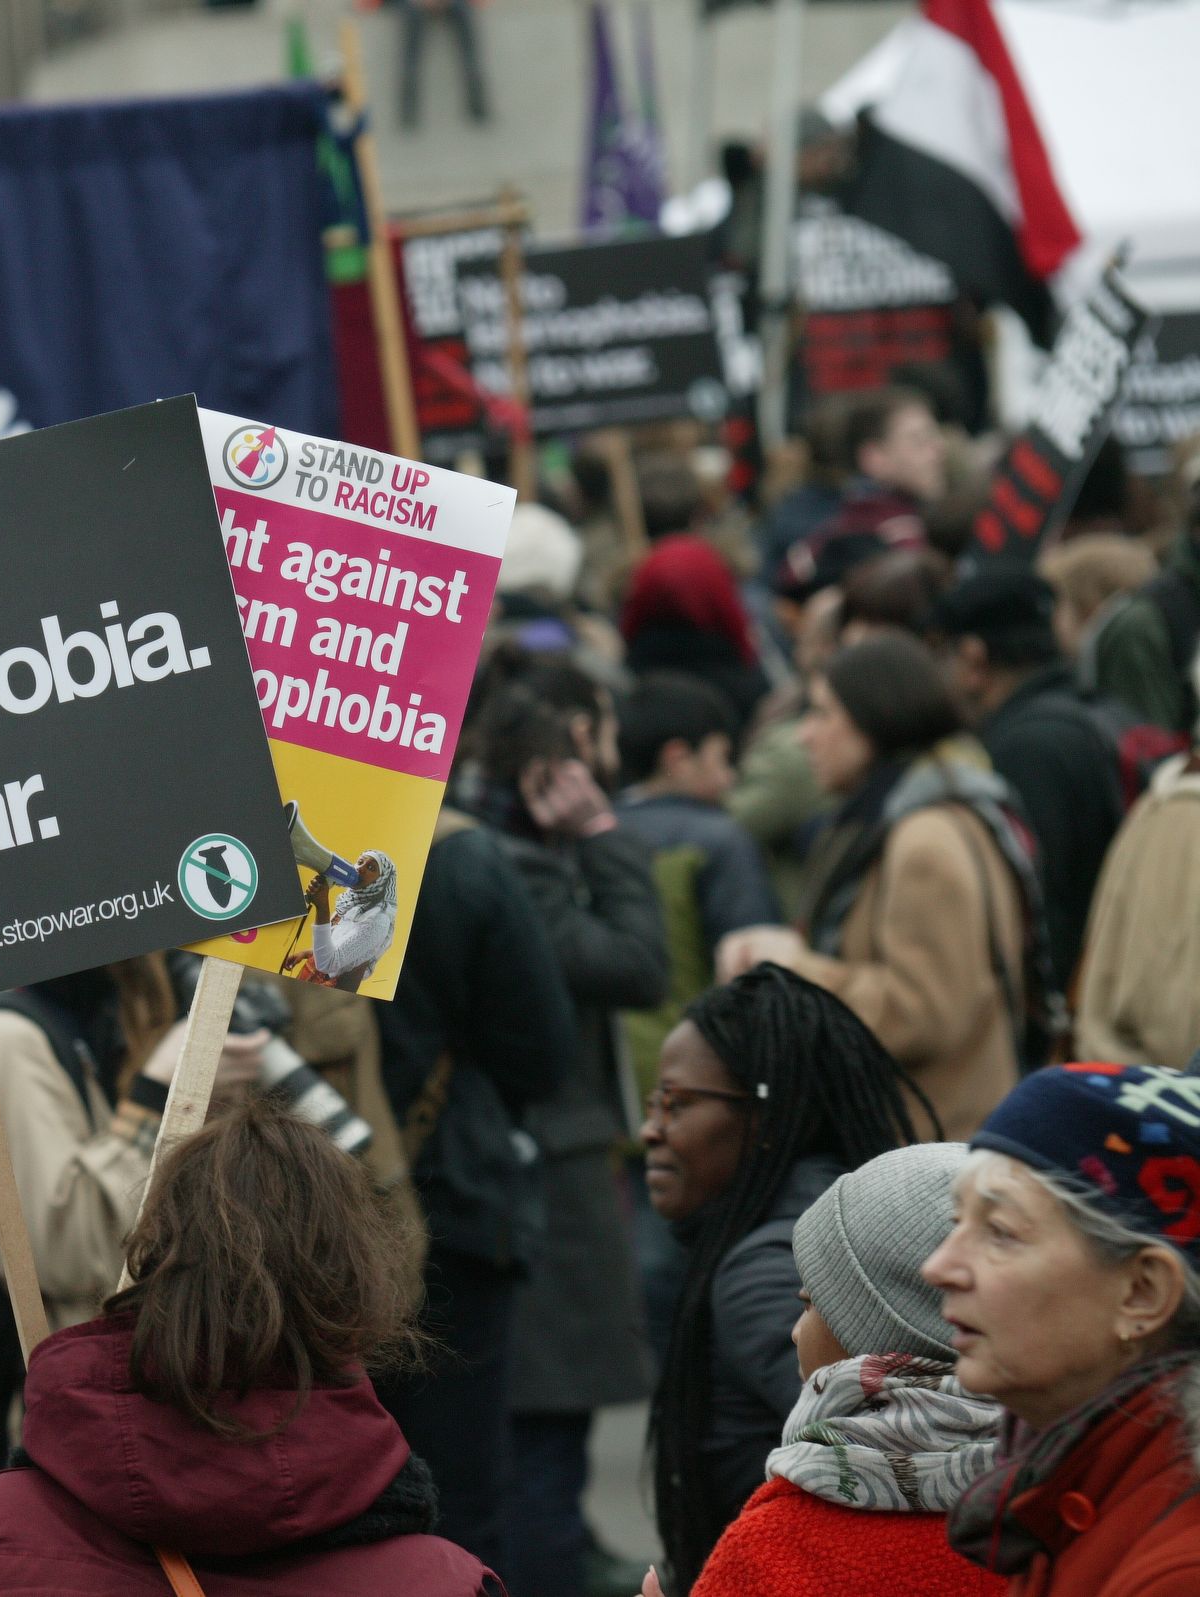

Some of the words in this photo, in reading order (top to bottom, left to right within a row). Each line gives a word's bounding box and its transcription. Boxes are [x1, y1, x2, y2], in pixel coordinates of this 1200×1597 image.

[299, 441, 385, 486] STAND
[391, 463, 431, 496] UP
[295, 469, 329, 502] TO
[334, 481, 439, 532] RACISM
[280, 541, 469, 624] against
[309, 618, 409, 676] and
[253, 668, 447, 755] ophobia
